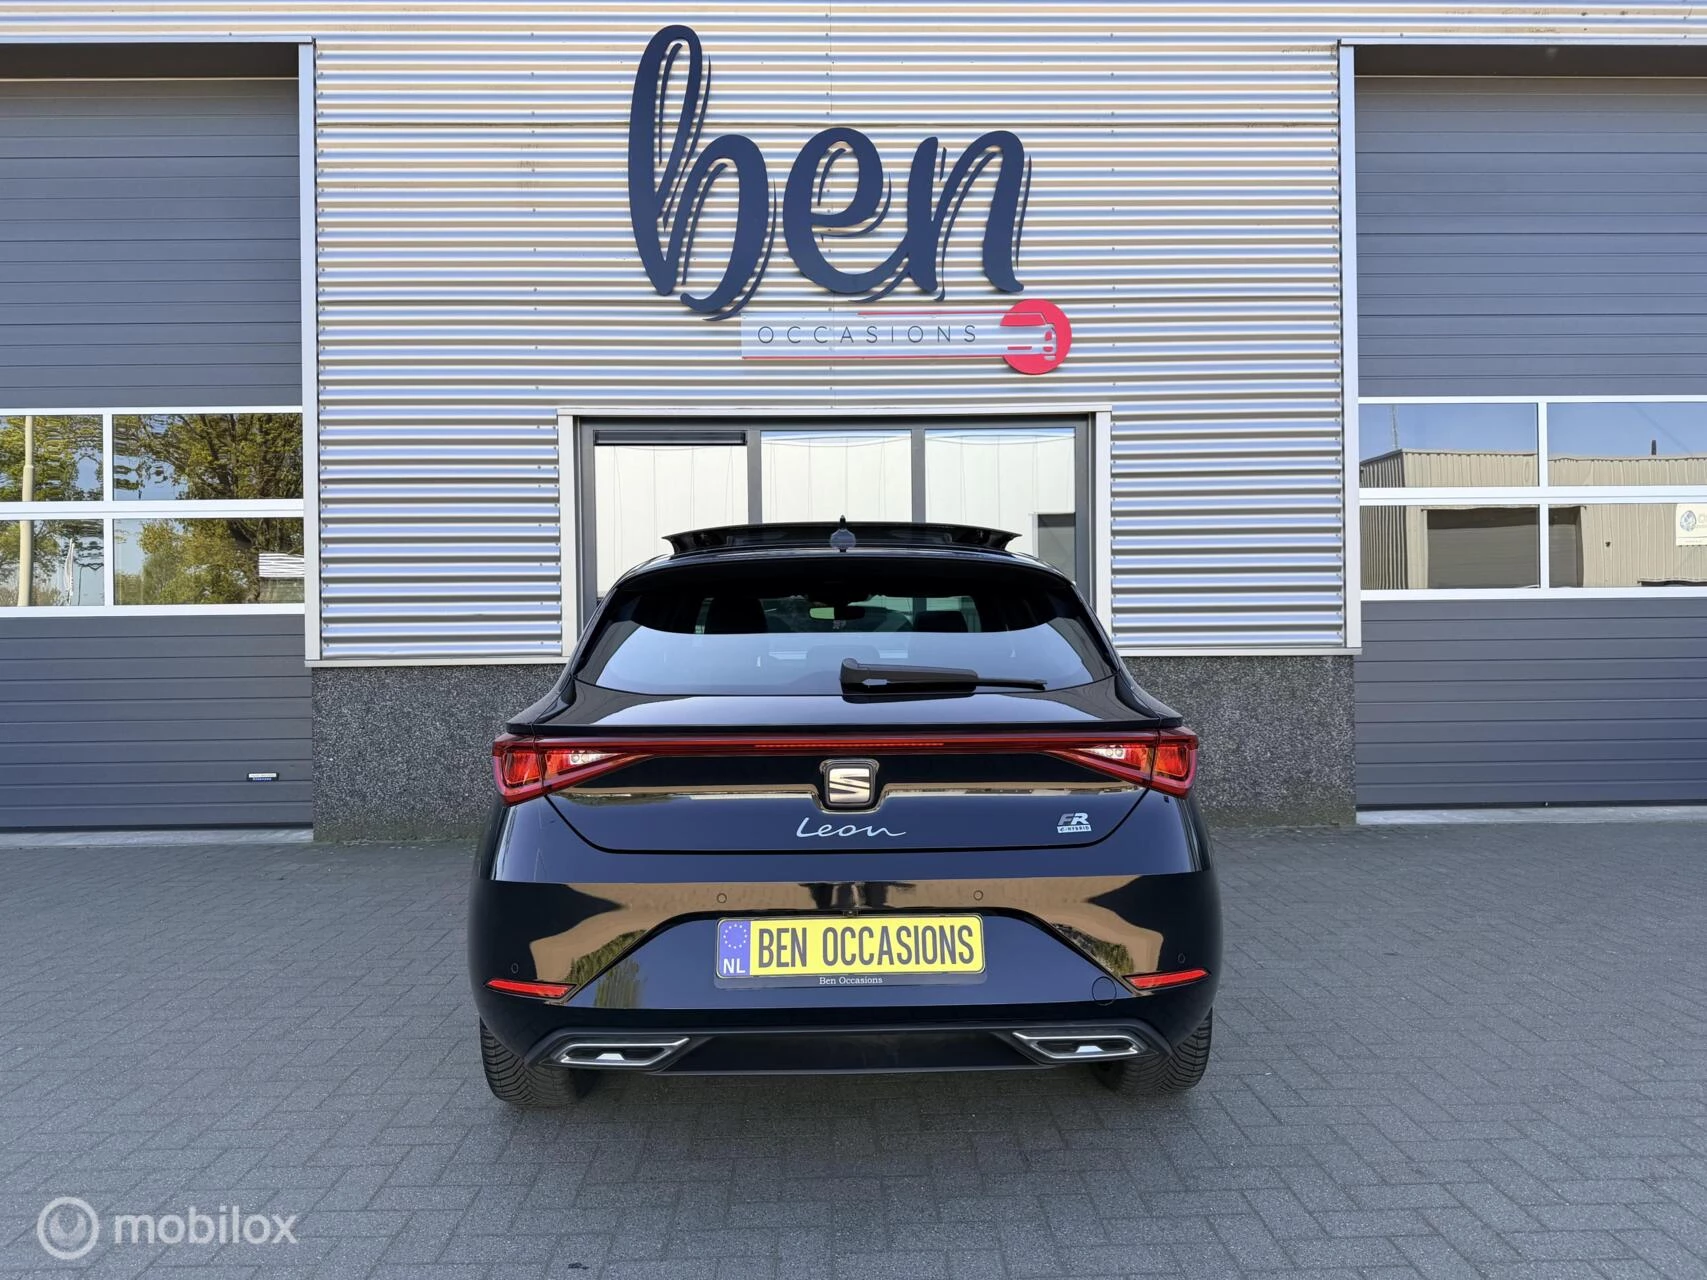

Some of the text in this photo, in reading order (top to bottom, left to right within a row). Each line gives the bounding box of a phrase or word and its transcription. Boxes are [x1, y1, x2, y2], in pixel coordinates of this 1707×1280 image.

[628, 25, 1032, 321] ben
[757, 324, 977, 345] OCCASIONS
[796, 817, 906, 837] Leon
[1057, 812, 1089, 826] FR
[758, 924, 974, 968] BEN OCCASIONS
[722, 958, 746, 974] NL
[819, 976, 883, 985] Ben Occasions
